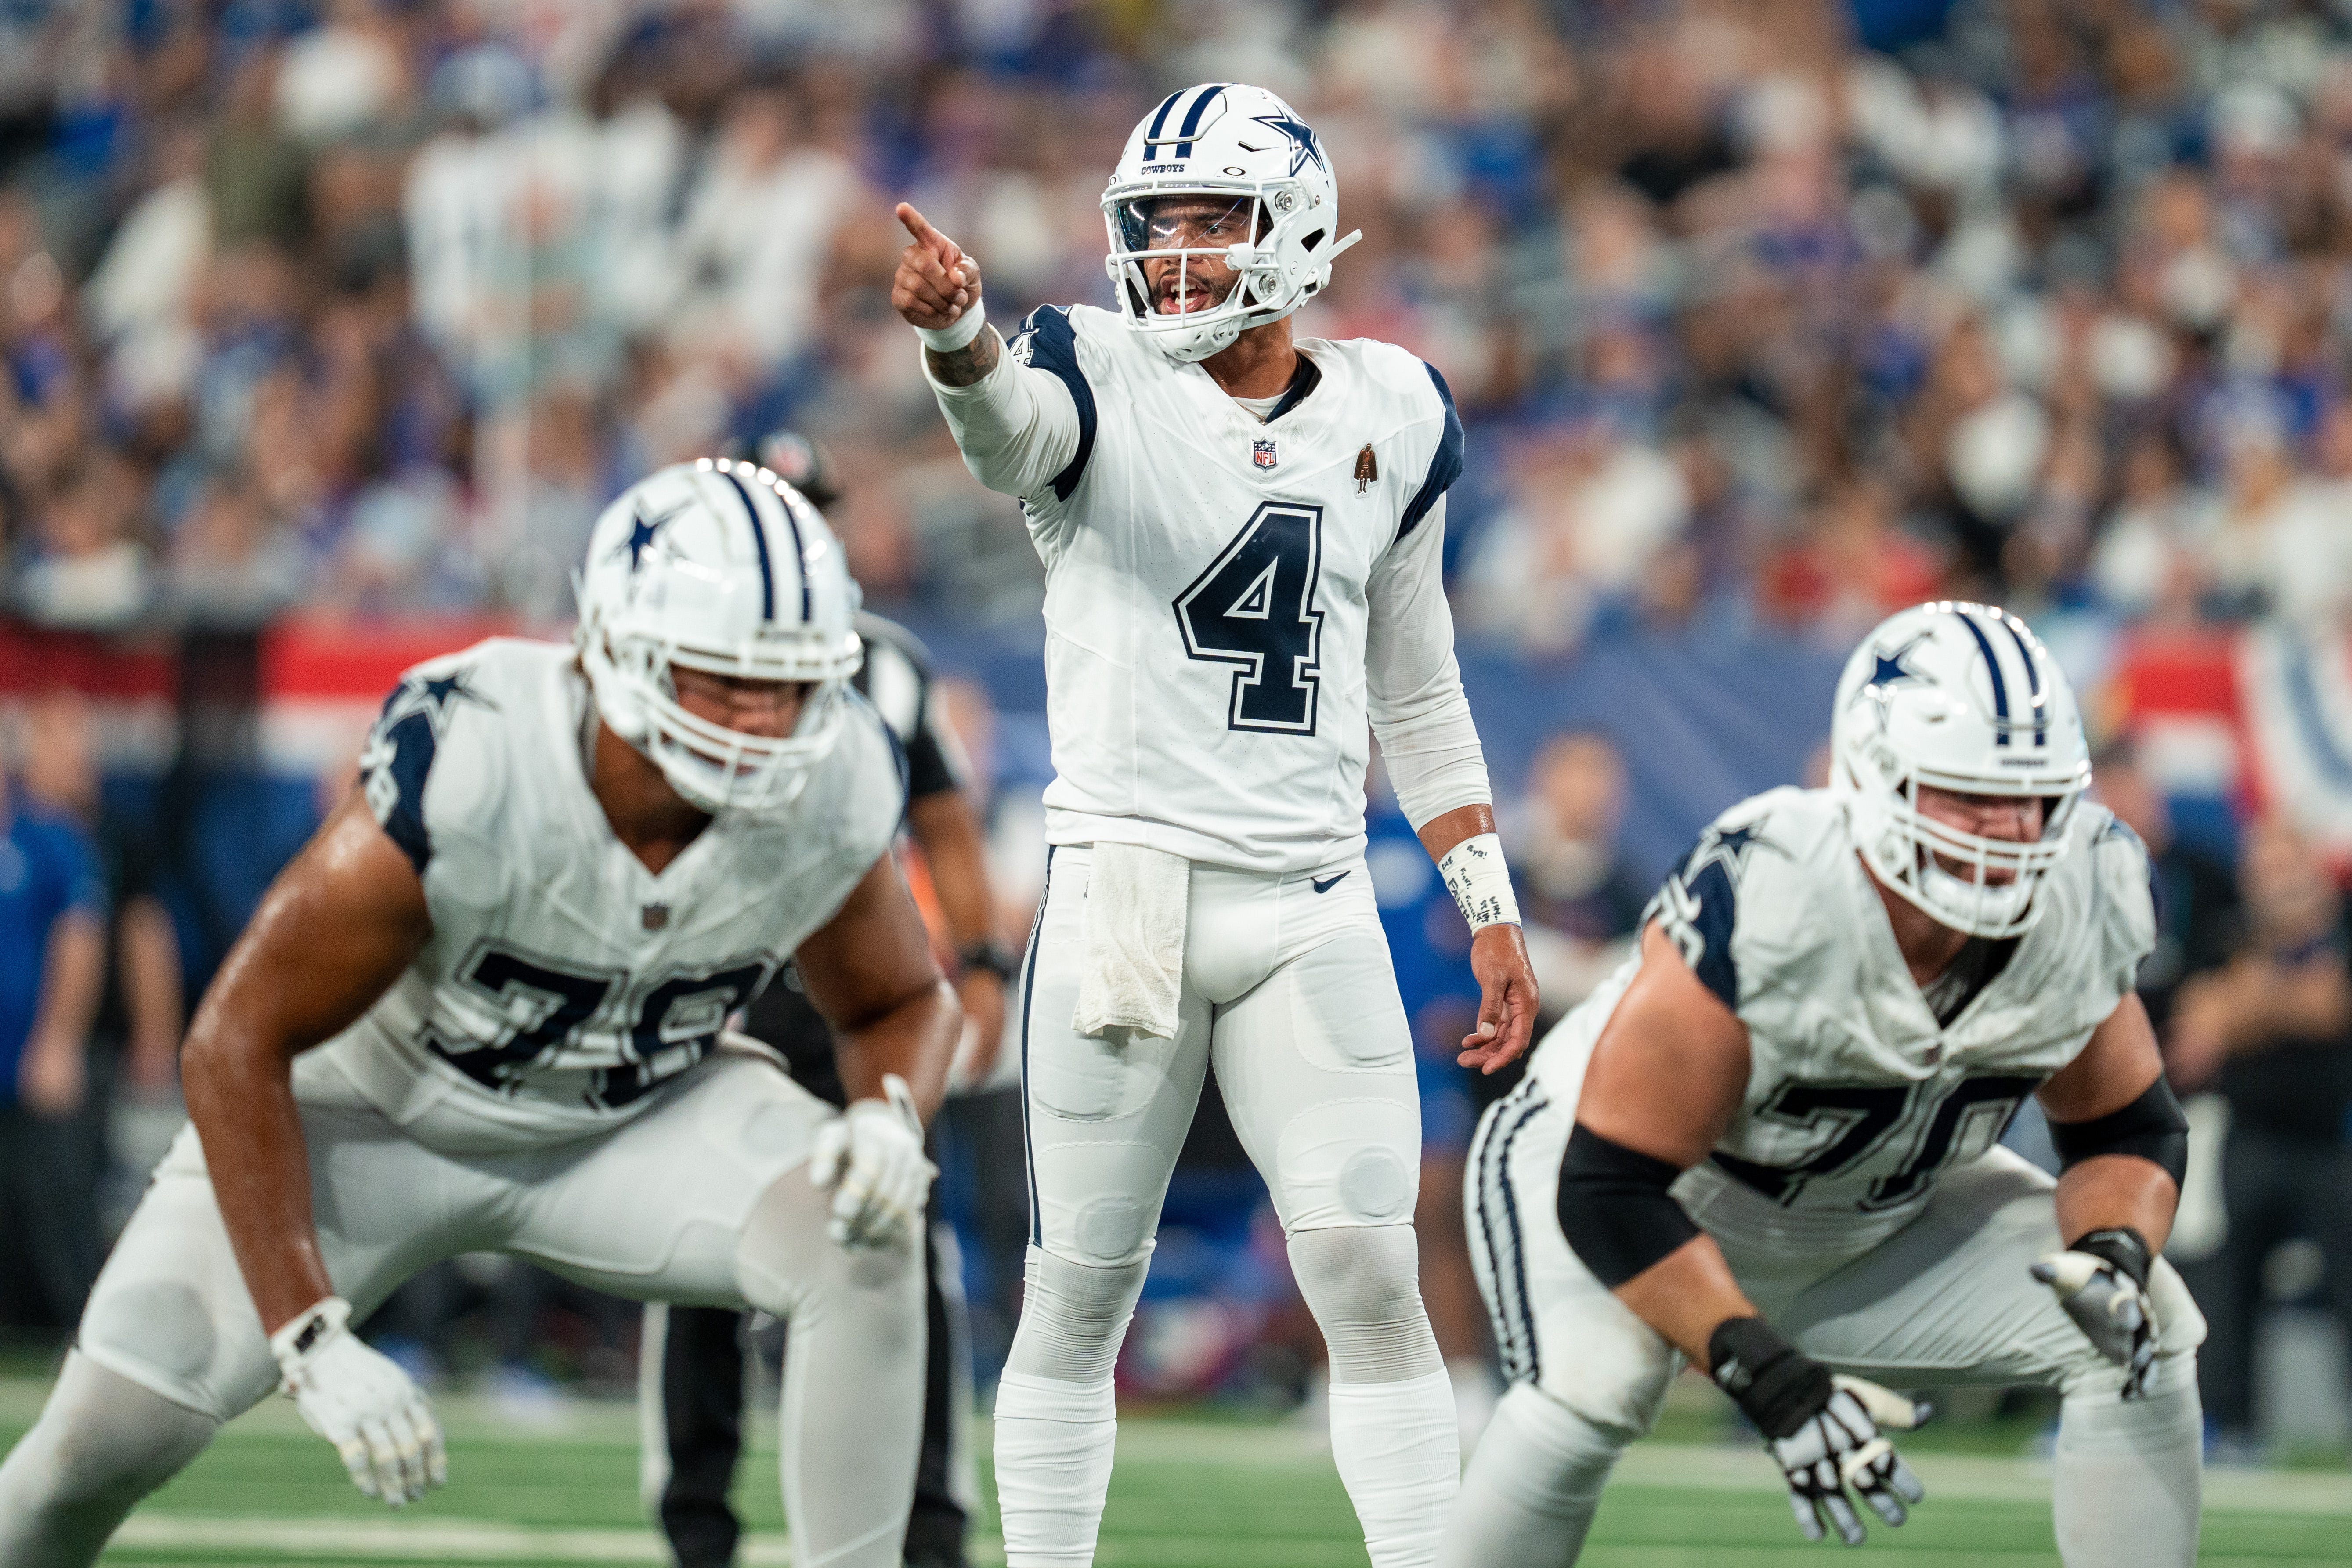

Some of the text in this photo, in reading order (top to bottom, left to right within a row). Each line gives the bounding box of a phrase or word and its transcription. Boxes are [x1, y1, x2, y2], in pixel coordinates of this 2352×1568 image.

[1141, 164, 1185, 175] COWBOYS
[1256, 452, 1275, 465] NFL
[1172, 501, 1325, 737] 4
